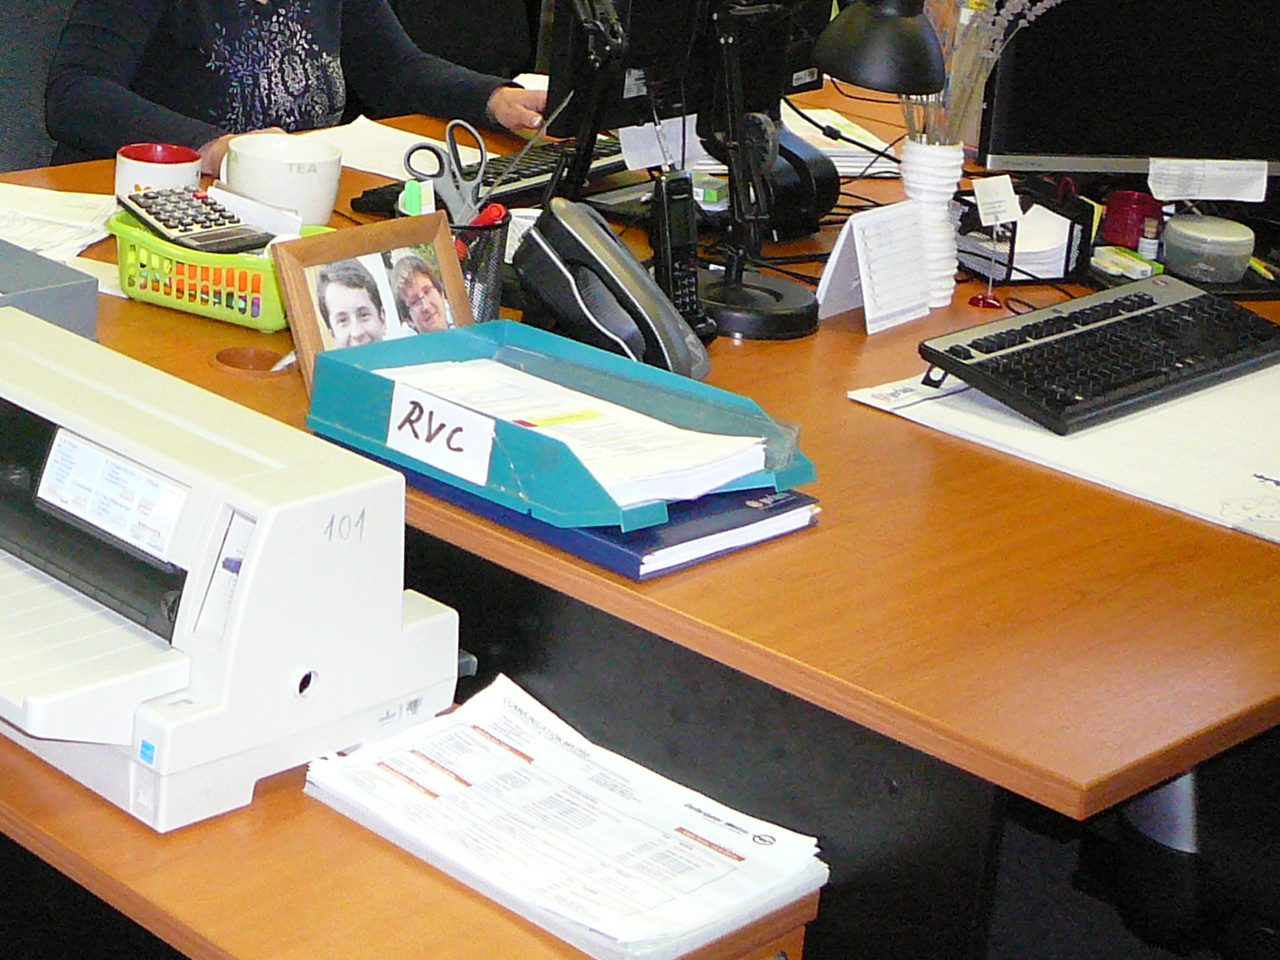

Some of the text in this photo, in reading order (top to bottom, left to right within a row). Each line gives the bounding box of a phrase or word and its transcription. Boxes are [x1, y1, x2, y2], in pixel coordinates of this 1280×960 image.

[286, 162, 319, 175] TEA
[397, 400, 465, 454] RVC
[323, 507, 366, 542] 101
